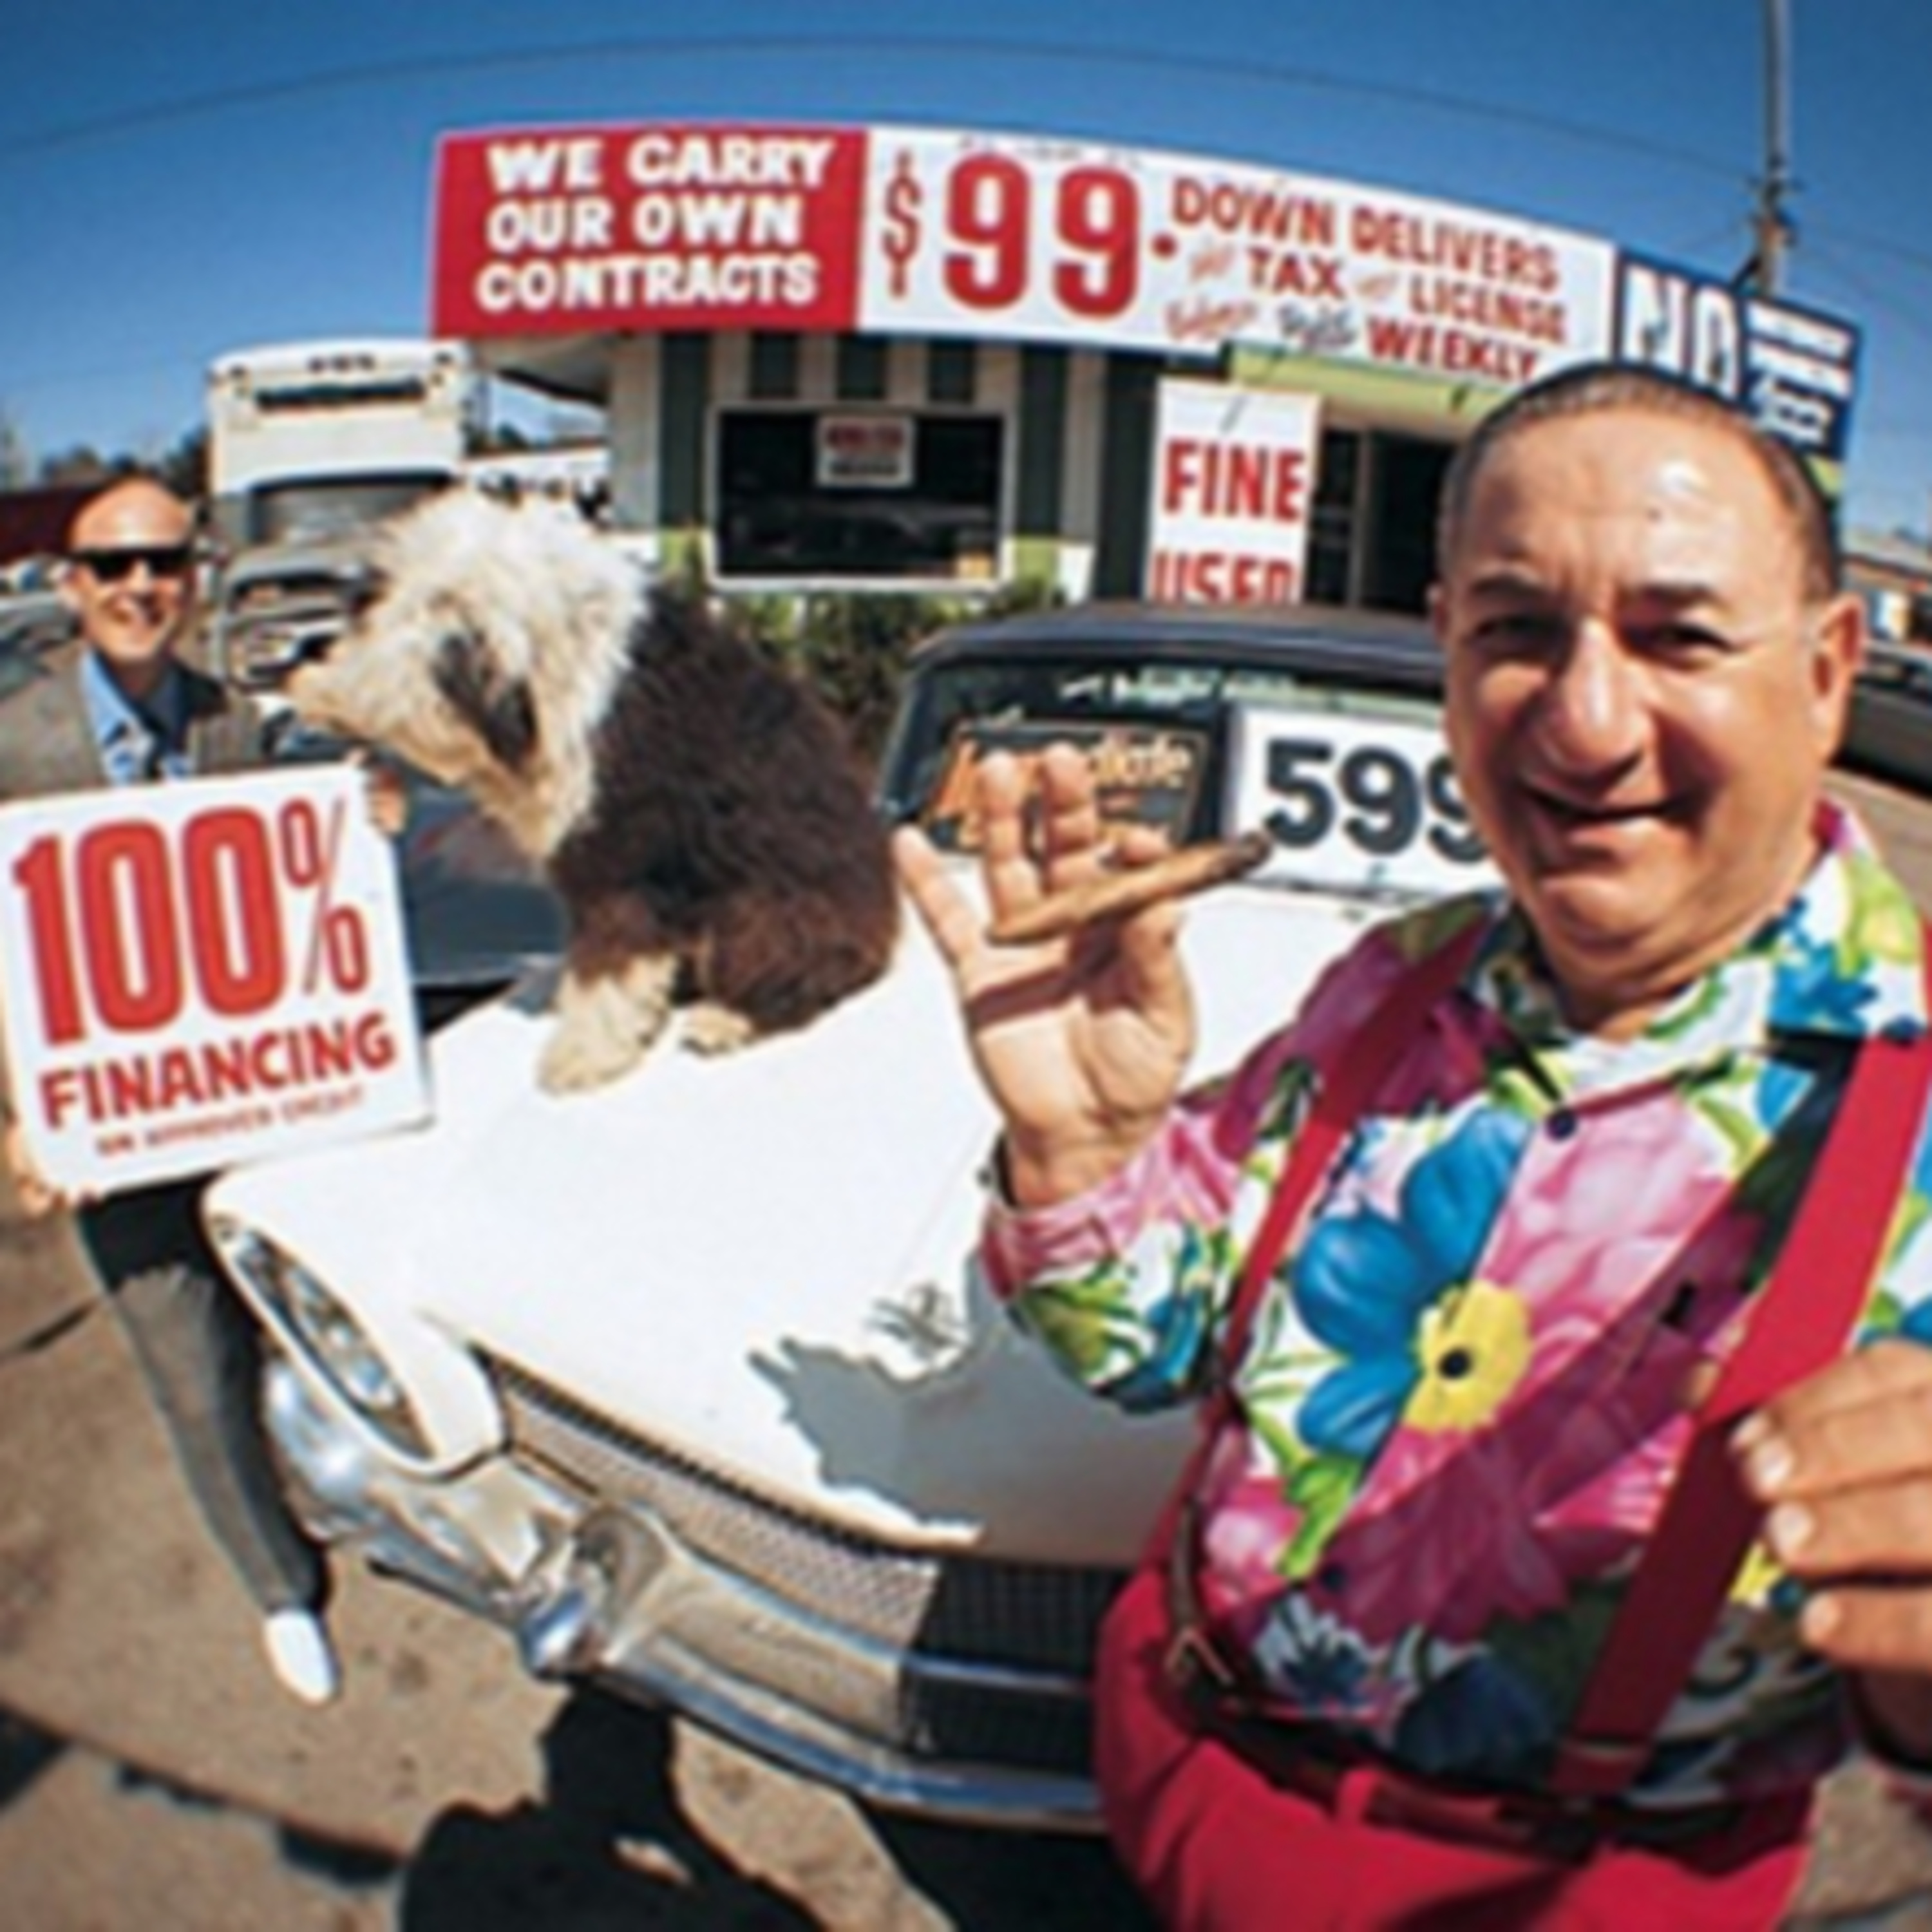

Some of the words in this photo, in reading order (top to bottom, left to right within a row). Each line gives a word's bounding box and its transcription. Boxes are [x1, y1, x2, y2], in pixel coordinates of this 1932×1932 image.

[486, 138, 601, 191] WE
[627, 133, 835, 188] CARRY
[486, 196, 615, 254] OUR
[632, 194, 803, 247] OWN
[1171, 176, 1336, 247] DOWN
[1350, 204, 1561, 292] DELIVERS
[475, 255, 820, 313] CONTRACTS
[1245, 245, 1346, 300] TAX
[1408, 276, 1567, 345] LICENSE
[1365, 316, 1539, 381] WEEKLY
[1622, 264, 1739, 402] NO
[1163, 438, 1307, 524] FINE
[12, 797, 370, 1048] 100%
[37, 1010, 397, 1132] FINANCING
